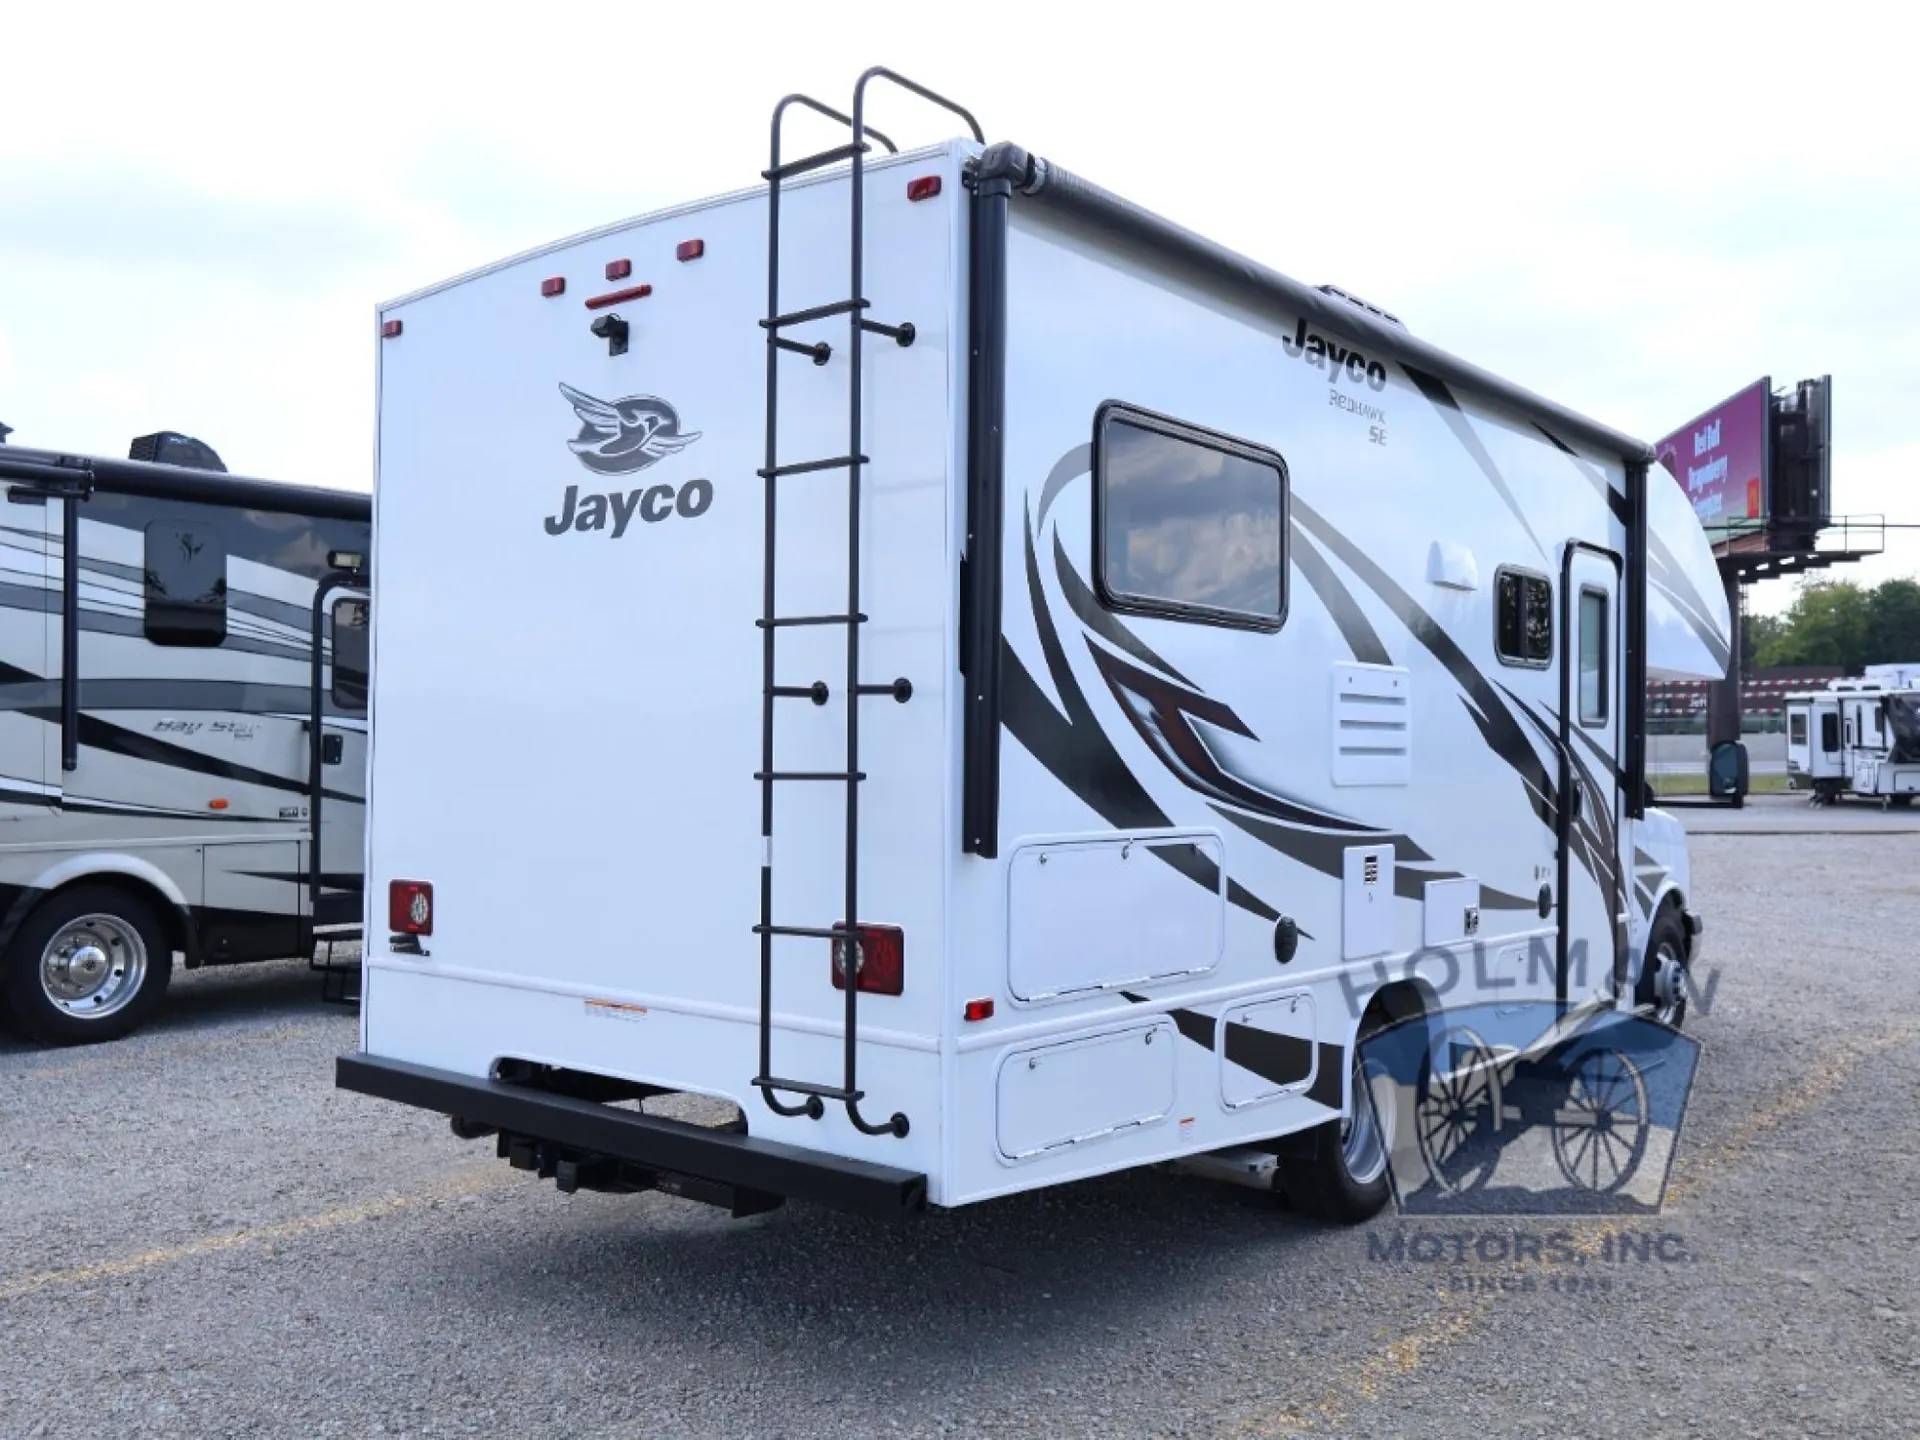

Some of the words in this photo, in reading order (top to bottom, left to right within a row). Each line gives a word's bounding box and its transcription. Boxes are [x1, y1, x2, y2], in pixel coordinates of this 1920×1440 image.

[1282, 318, 1387, 392] Jayco
[1368, 424, 1388, 447] SE
[544, 478, 714, 539] Jayco
